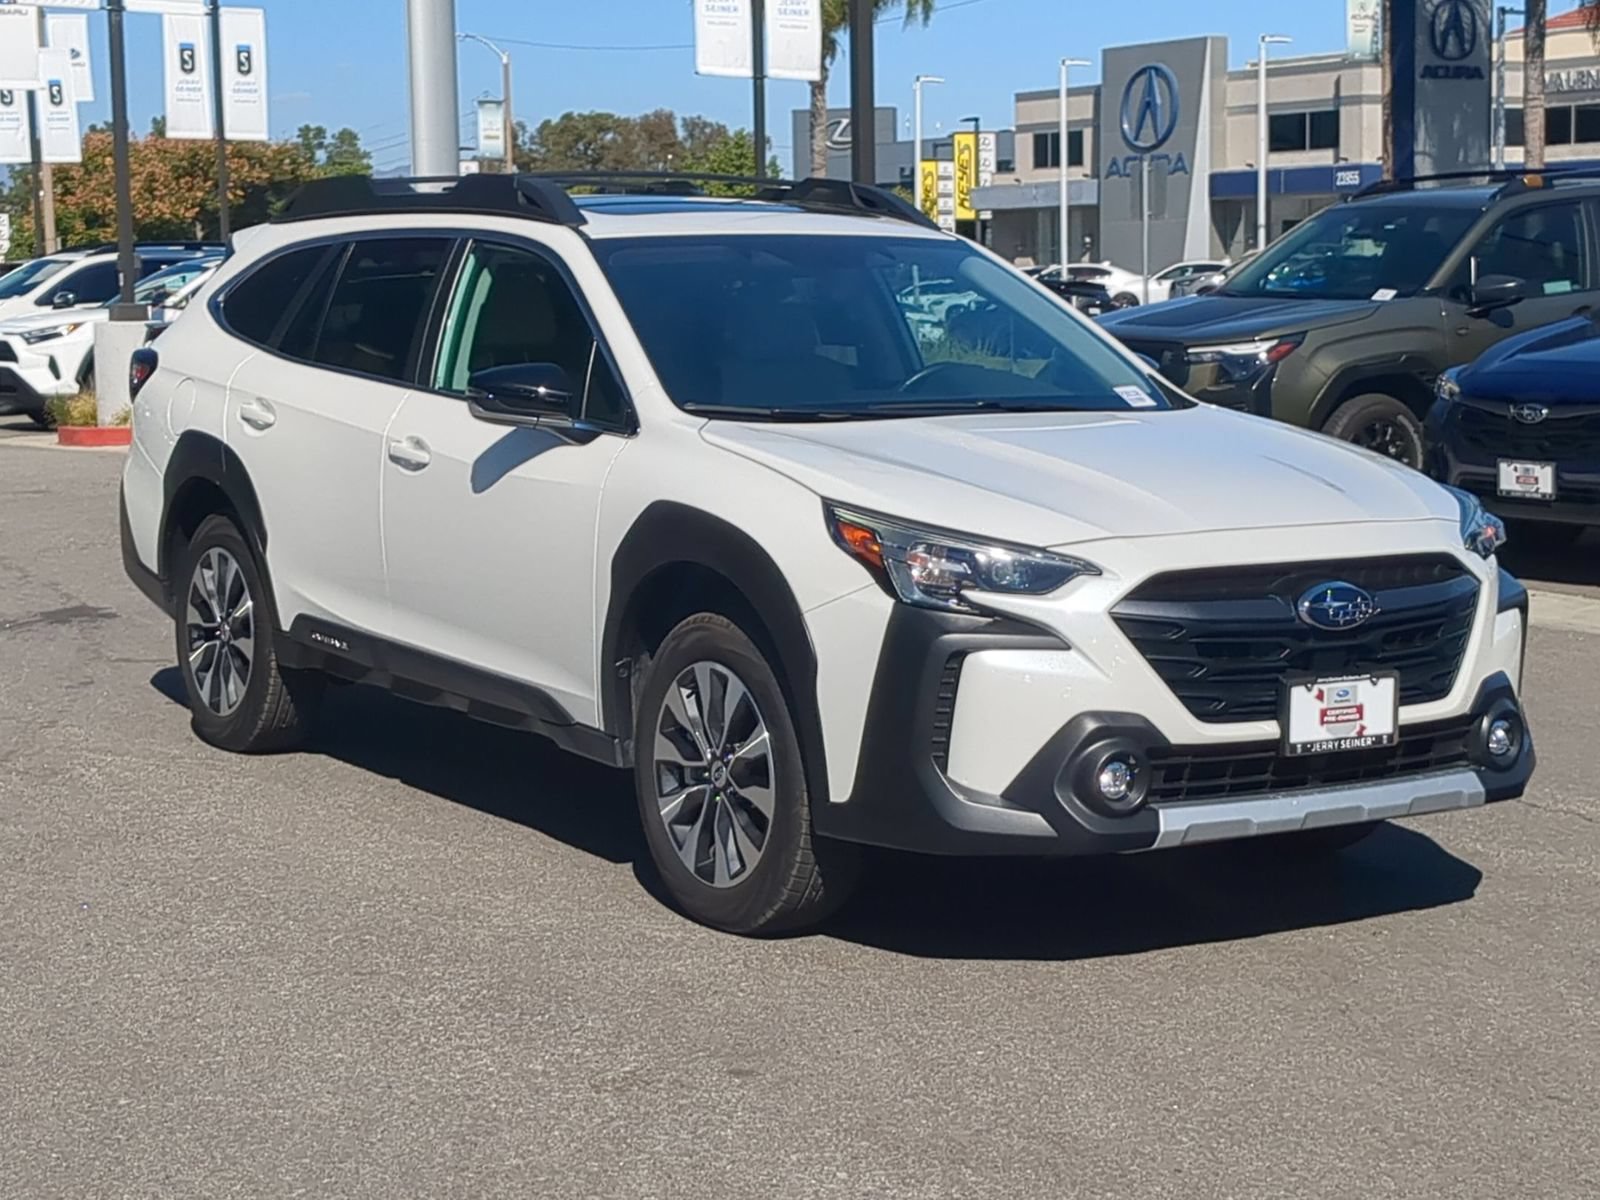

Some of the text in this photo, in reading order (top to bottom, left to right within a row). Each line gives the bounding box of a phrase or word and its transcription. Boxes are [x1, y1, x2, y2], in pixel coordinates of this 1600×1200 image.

[1420, 65, 1485, 79] ACURA
[1326, 707, 1358, 716] CERTIFIED
[1323, 713, 1360, 722] PRE-OWNED
[1311, 737, 1372, 752] JERRY SEINER
